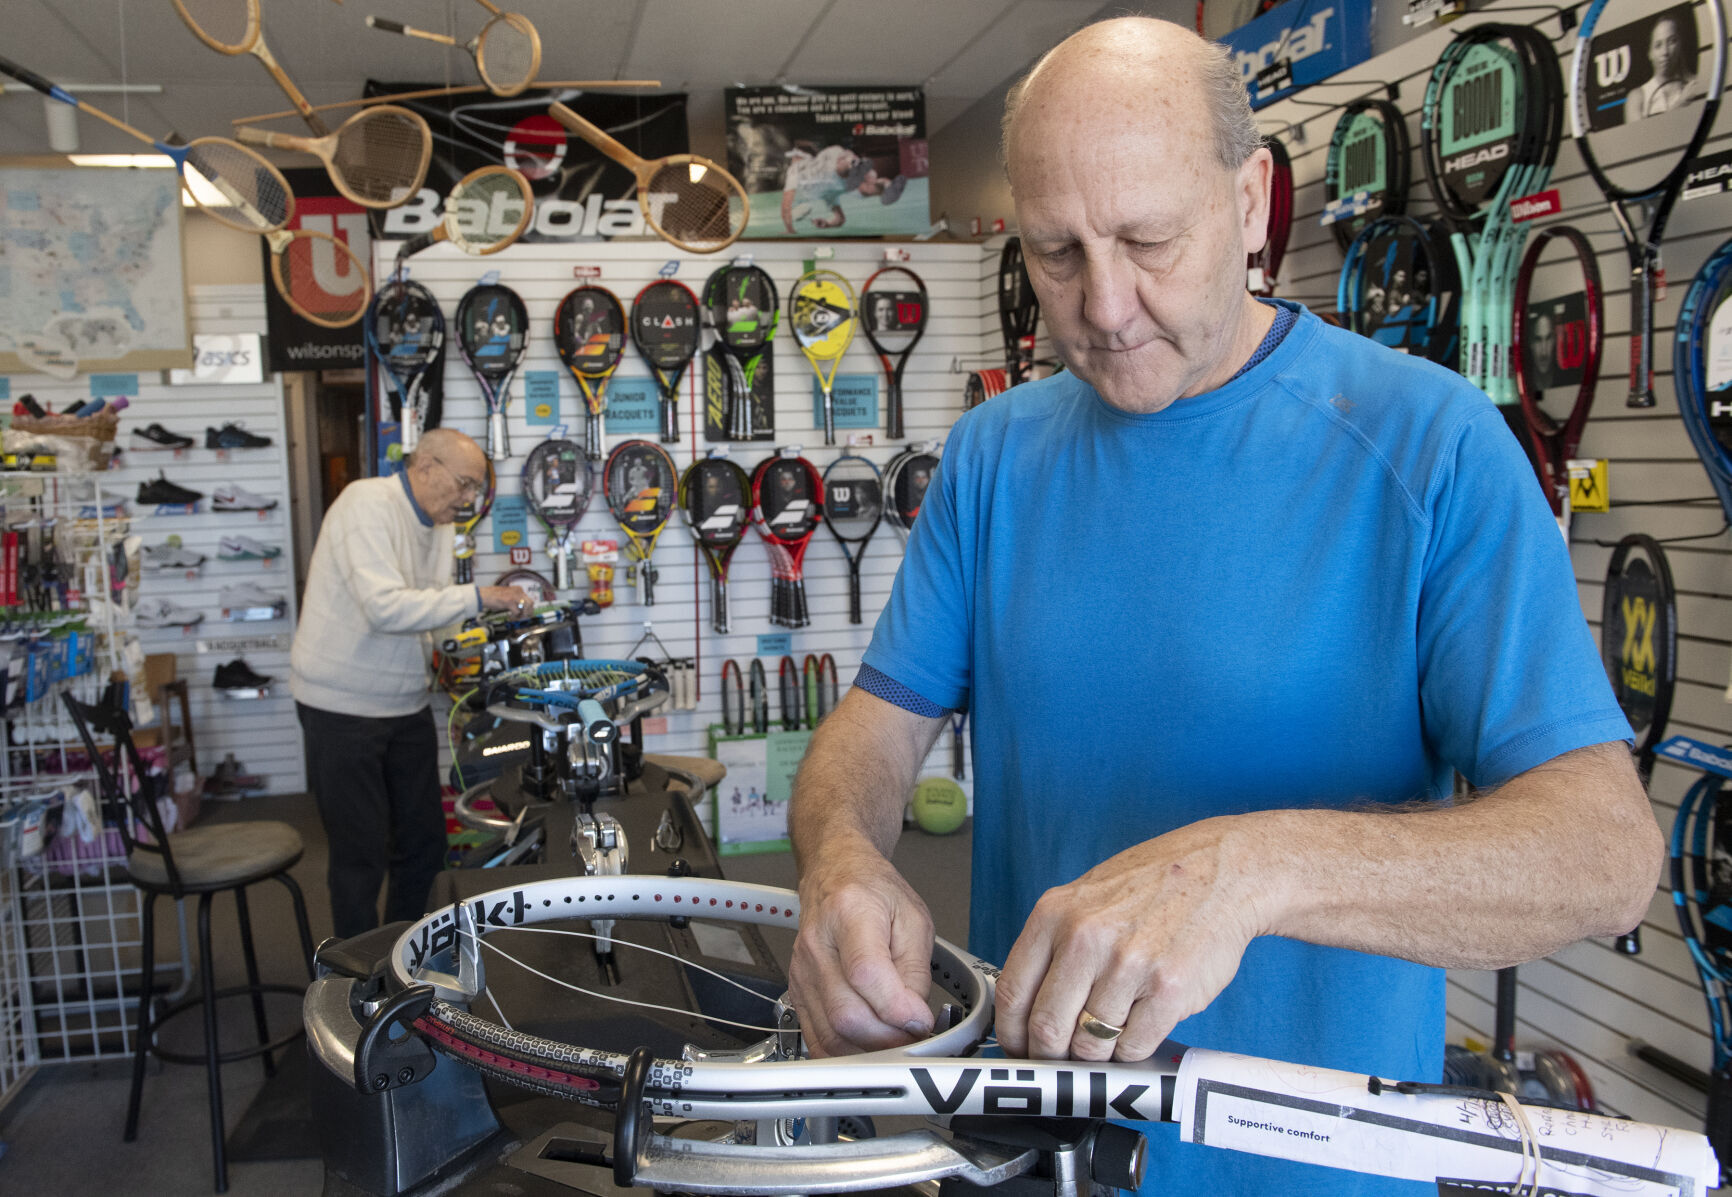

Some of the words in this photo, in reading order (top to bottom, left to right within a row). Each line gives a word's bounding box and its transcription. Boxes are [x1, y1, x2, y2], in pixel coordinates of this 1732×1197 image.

[1594, 44, 1631, 87] W
[1445, 143, 1509, 173] HEAD
[1511, 199, 1552, 219] Wilson
[642, 314, 694, 328] CLASH
[202, 350, 250, 367] asics
[612, 391, 646, 403] JUNIOR
[707, 353, 723, 430] AERO
[409, 890, 524, 969] Vökl
[909, 1067, 1177, 1122] Völkl
[1227, 1114, 1285, 1134] Supportive
[1286, 1127, 1332, 1144] comfort
